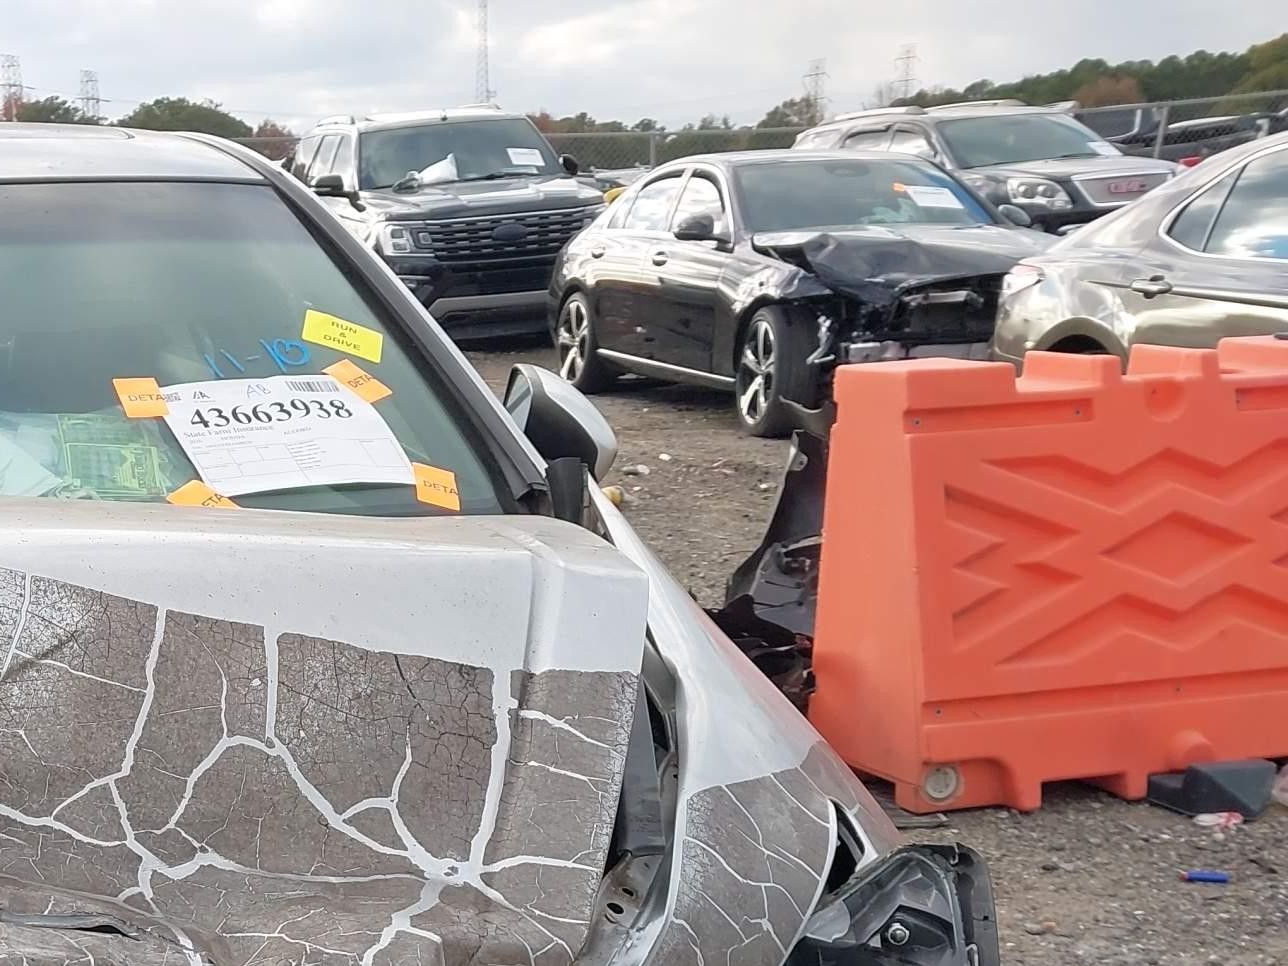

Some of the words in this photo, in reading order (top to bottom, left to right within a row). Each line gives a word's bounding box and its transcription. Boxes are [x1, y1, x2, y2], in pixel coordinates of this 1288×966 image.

[331, 321, 358, 334] RUN
[323, 334, 361, 351] DRIVE
[190, 398, 353, 429] 43663938
